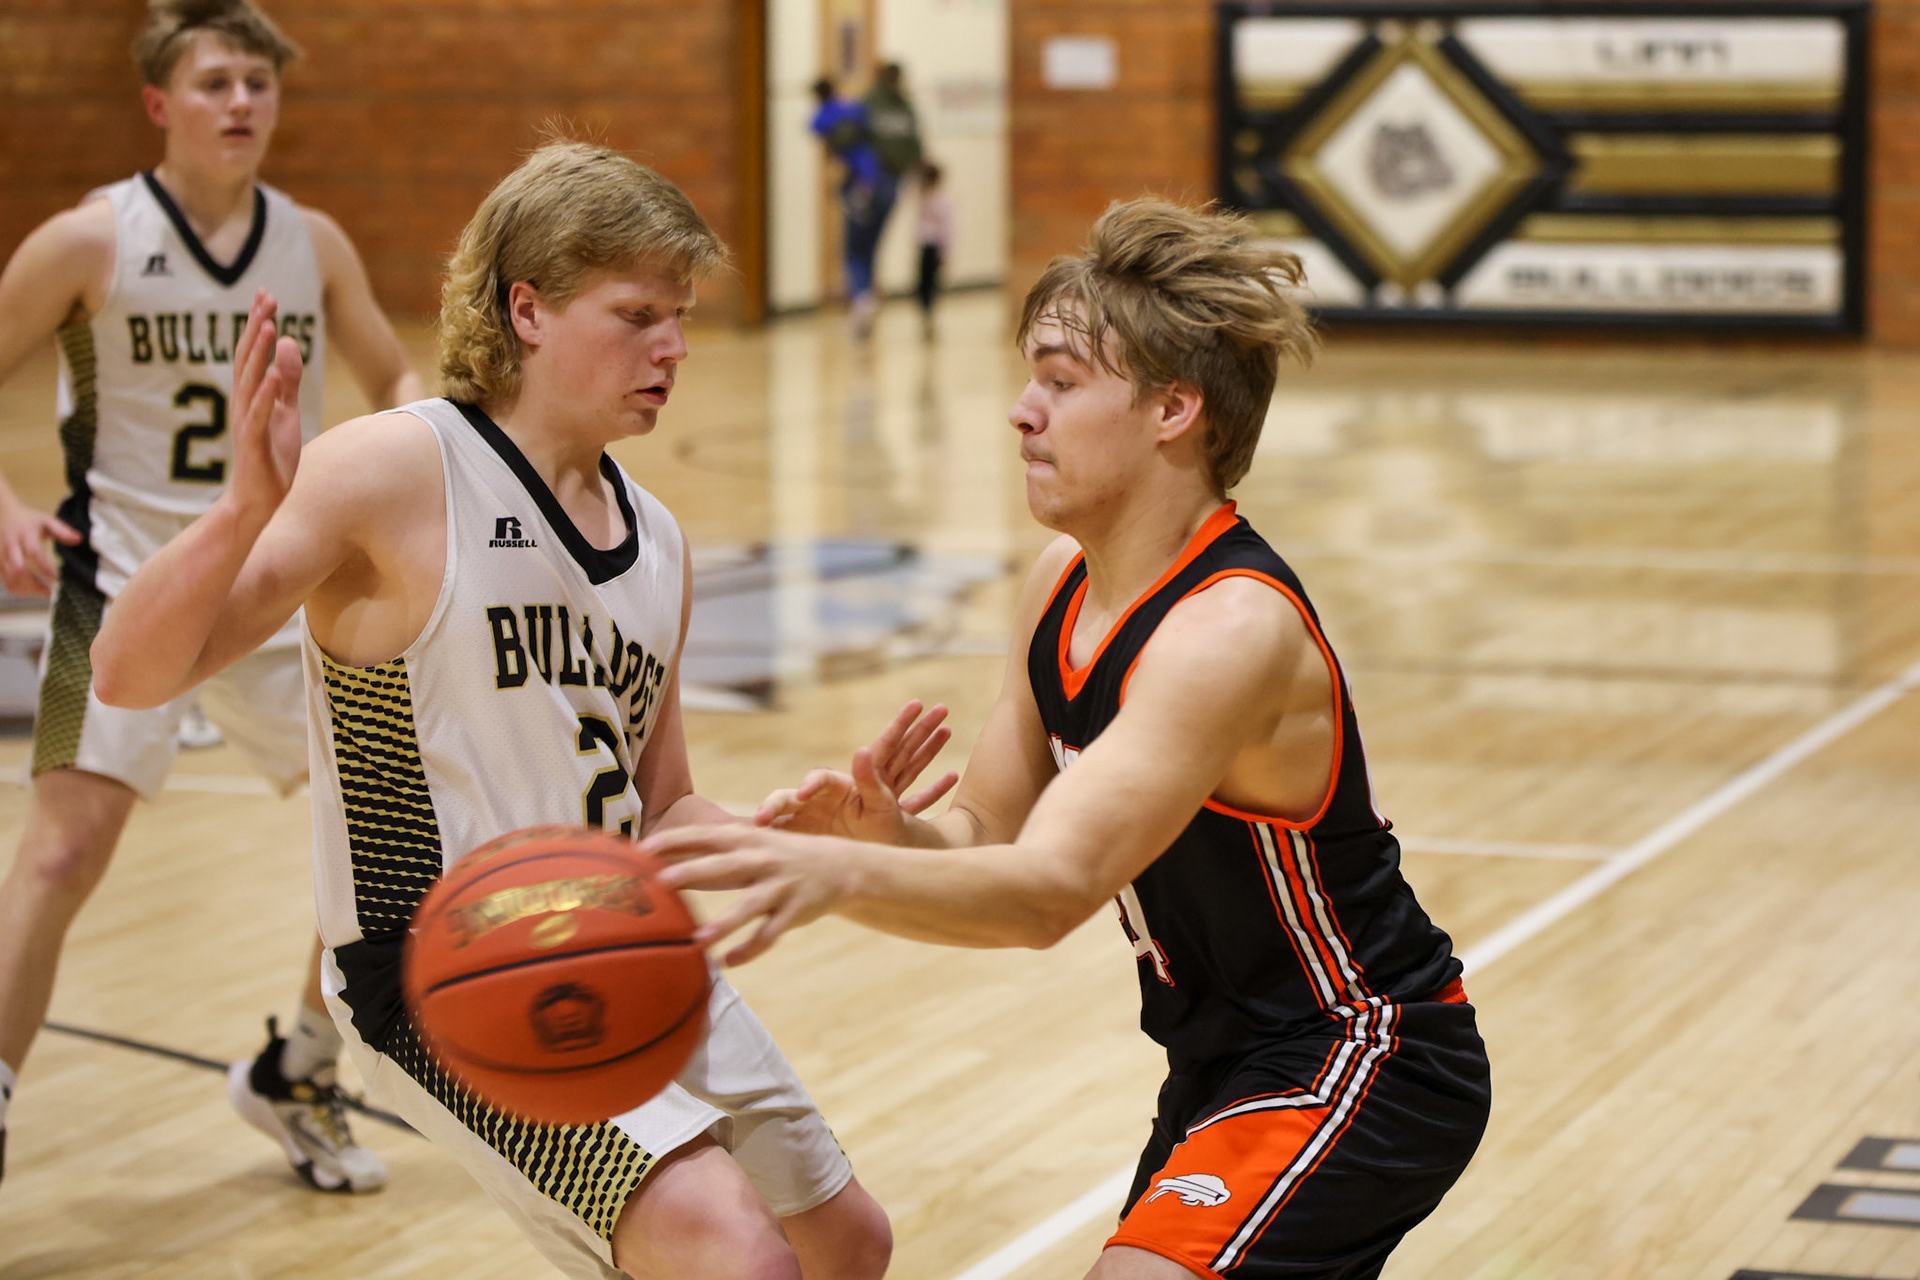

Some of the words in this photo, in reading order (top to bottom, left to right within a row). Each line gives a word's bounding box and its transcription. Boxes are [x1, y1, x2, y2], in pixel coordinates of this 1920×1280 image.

[170, 379, 229, 483] 2
[488, 539, 538, 548] RUSSELL
[574, 712, 637, 834] 2
